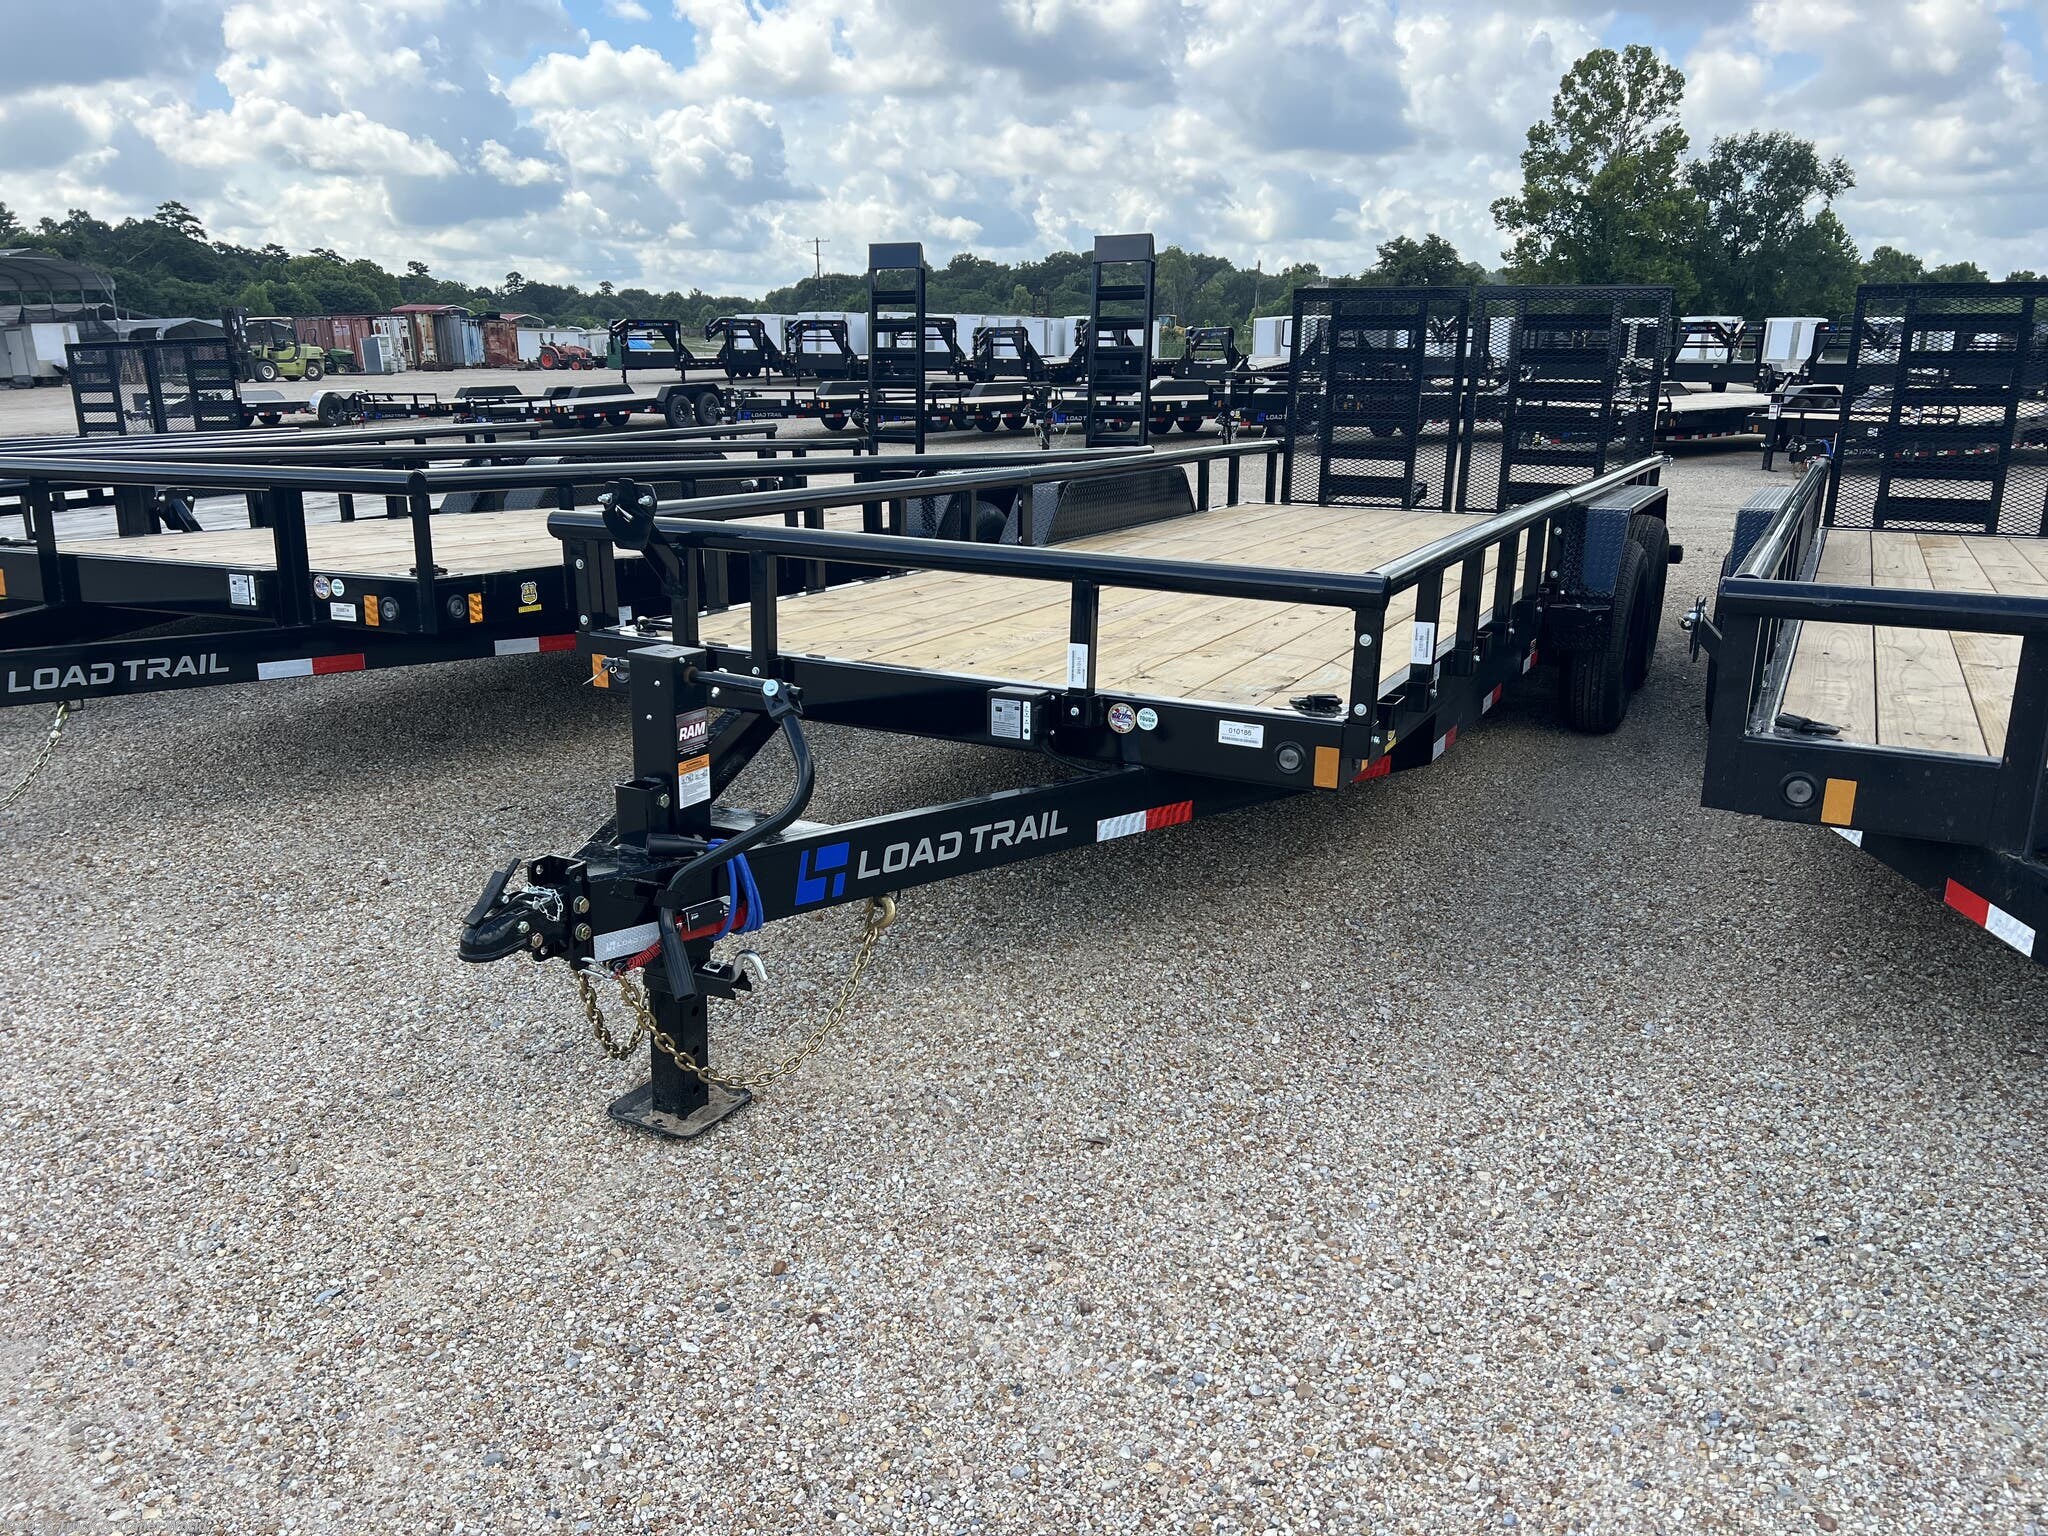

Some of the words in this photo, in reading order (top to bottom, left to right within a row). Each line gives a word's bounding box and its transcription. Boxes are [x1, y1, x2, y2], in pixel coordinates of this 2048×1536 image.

[8, 662, 115, 693] LOAD
[122, 653, 230, 681] TRAIL
[679, 721, 706, 742] RAM
[857, 830, 963, 880] LOAD
[970, 810, 1069, 853] TRAIL
